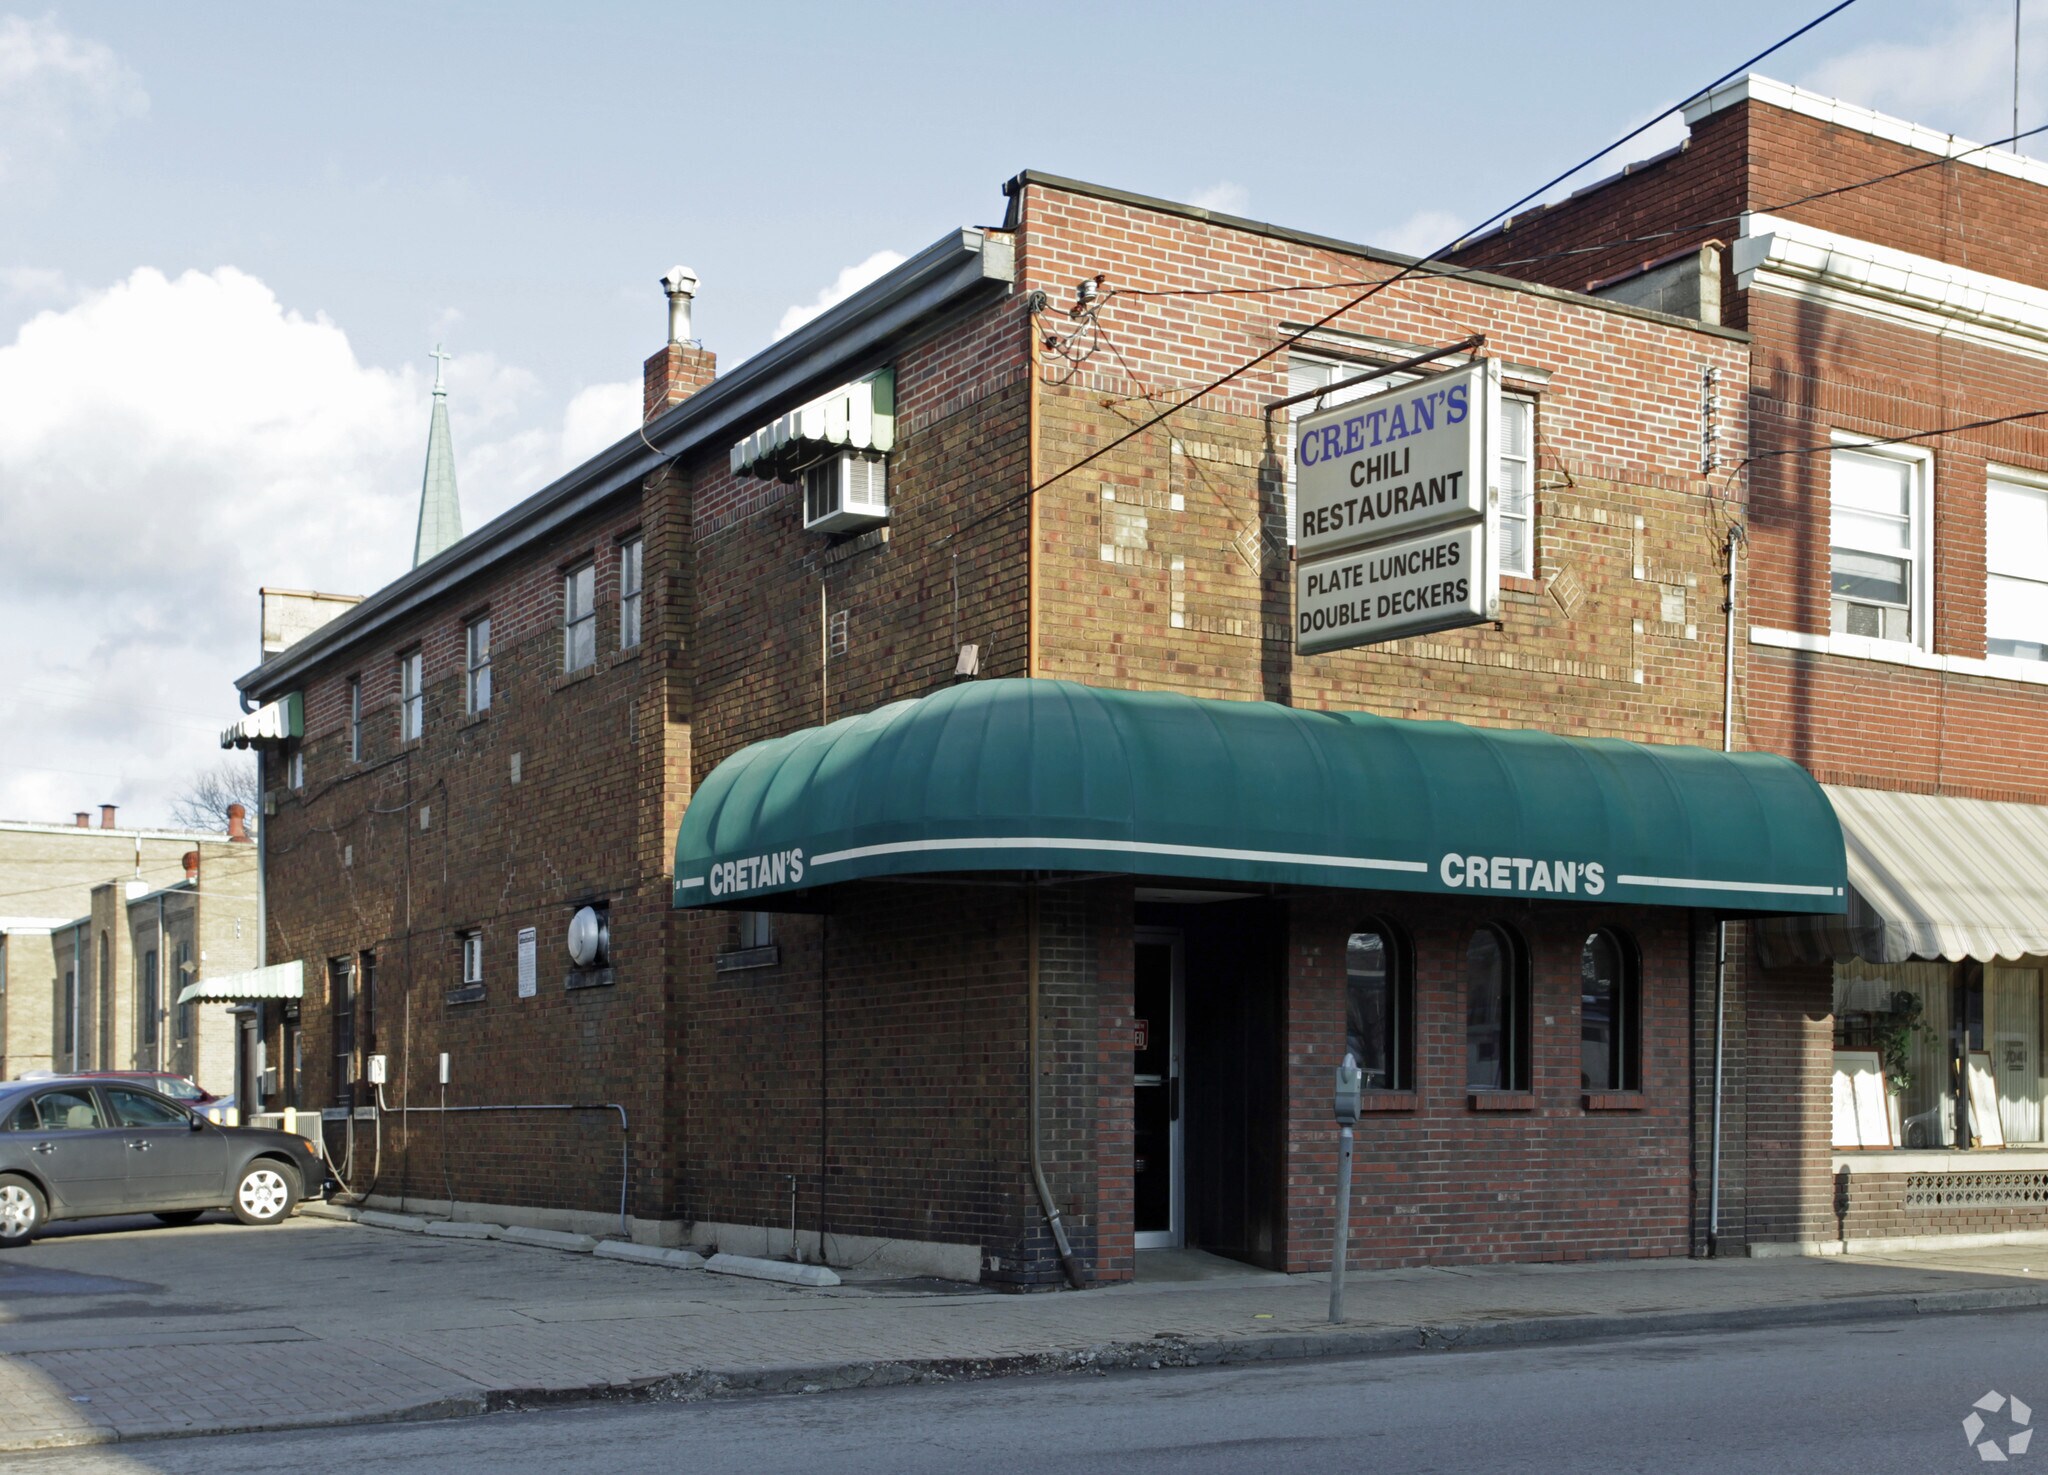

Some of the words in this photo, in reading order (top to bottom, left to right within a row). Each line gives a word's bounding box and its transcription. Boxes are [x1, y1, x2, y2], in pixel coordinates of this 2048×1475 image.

[1300, 384, 1468, 466] CRETAN'S
[1351, 447, 1410, 488] CHILI
[1303, 471, 1463, 538] RESTAURANT
[1307, 564, 1363, 597] PLATE
[1369, 542, 1460, 583] LUNCHES
[1300, 598, 1371, 634] DOUBLE
[1377, 578, 1468, 618] DECKERS
[710, 848, 804, 896] CRETAN'S
[1440, 853, 1605, 895] CRETAN'S
